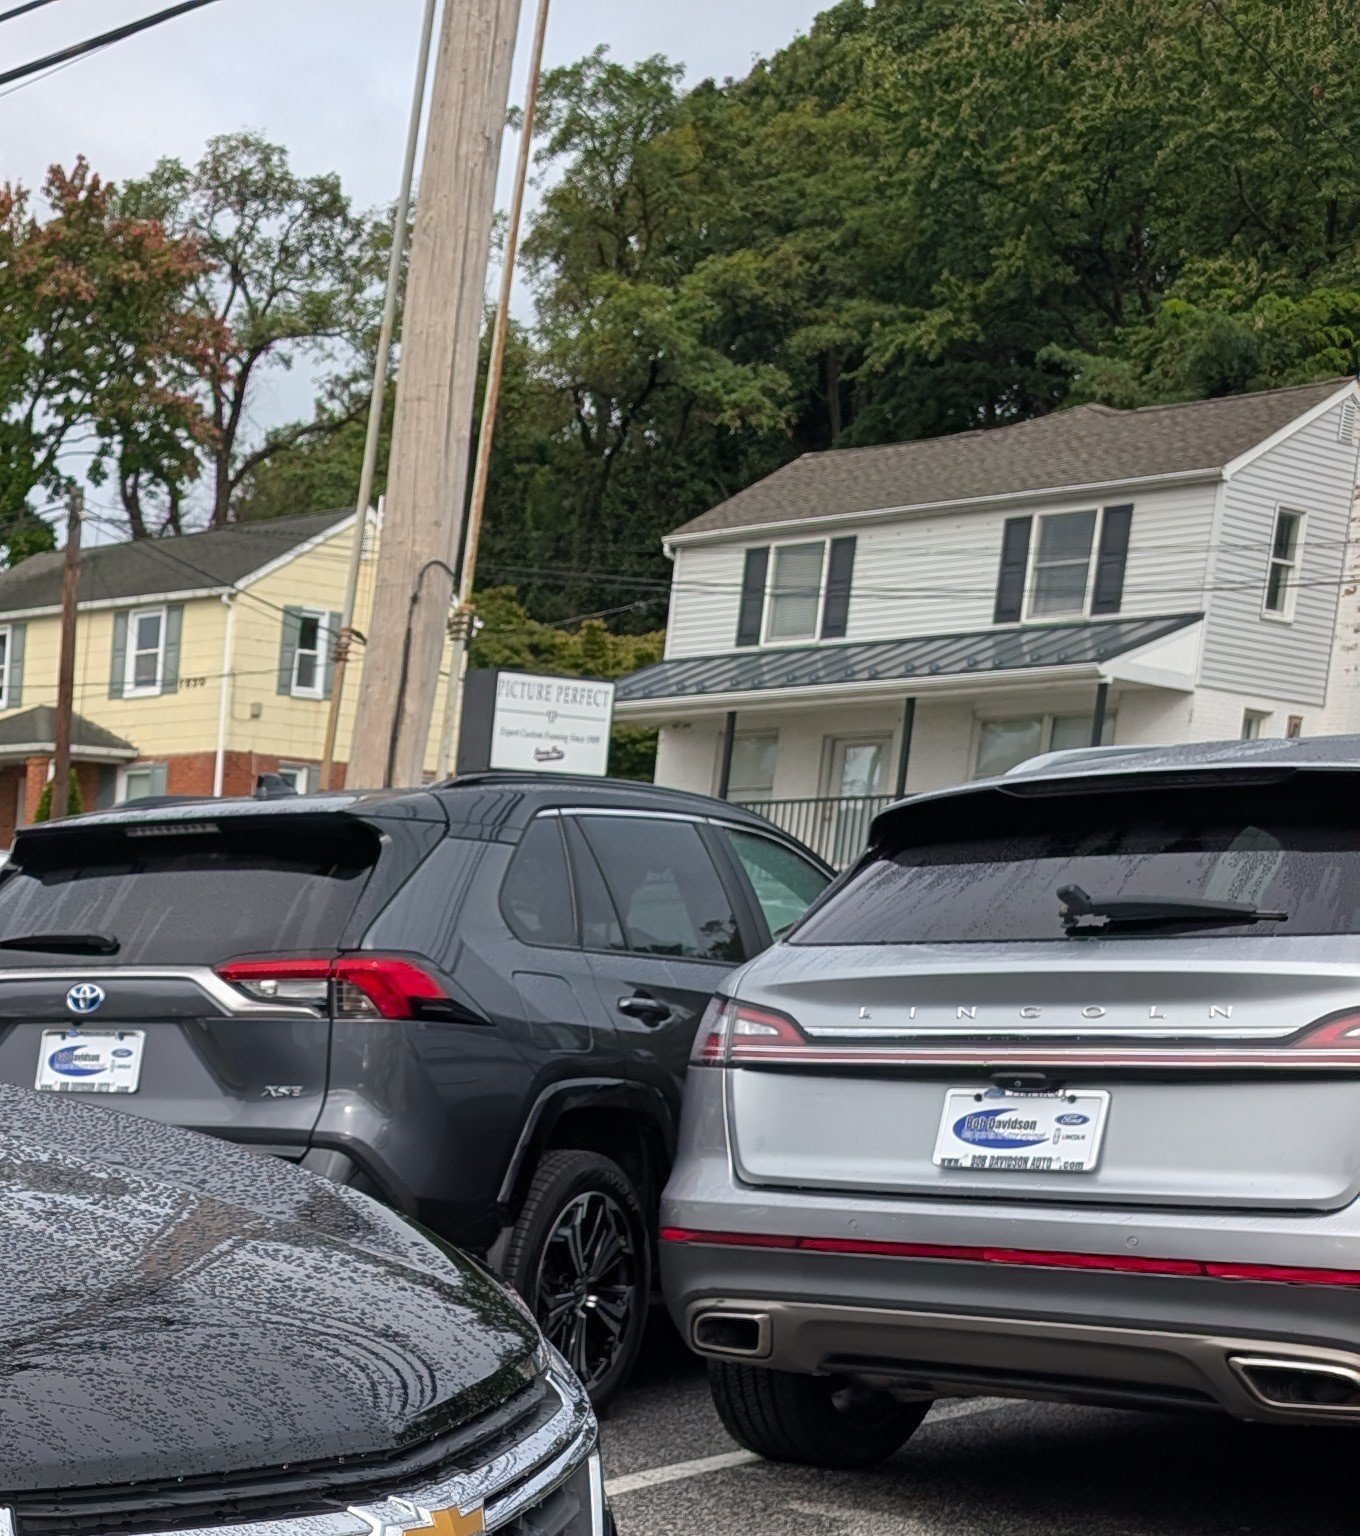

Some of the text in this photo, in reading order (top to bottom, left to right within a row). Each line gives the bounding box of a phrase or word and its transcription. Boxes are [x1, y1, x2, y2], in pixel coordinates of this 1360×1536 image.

[497, 678, 610, 708] PICTURE PERFECT
[858, 1004, 1234, 1021] LINCOLN
[965, 1116, 1037, 1131] Bob Davidson
[1061, 1115, 1083, 1125] Ford
[971, 1154, 988, 1168] BOB
[989, 1155, 1029, 1169] DAVIDSON
[1030, 1156, 1053, 1170] AUTO
